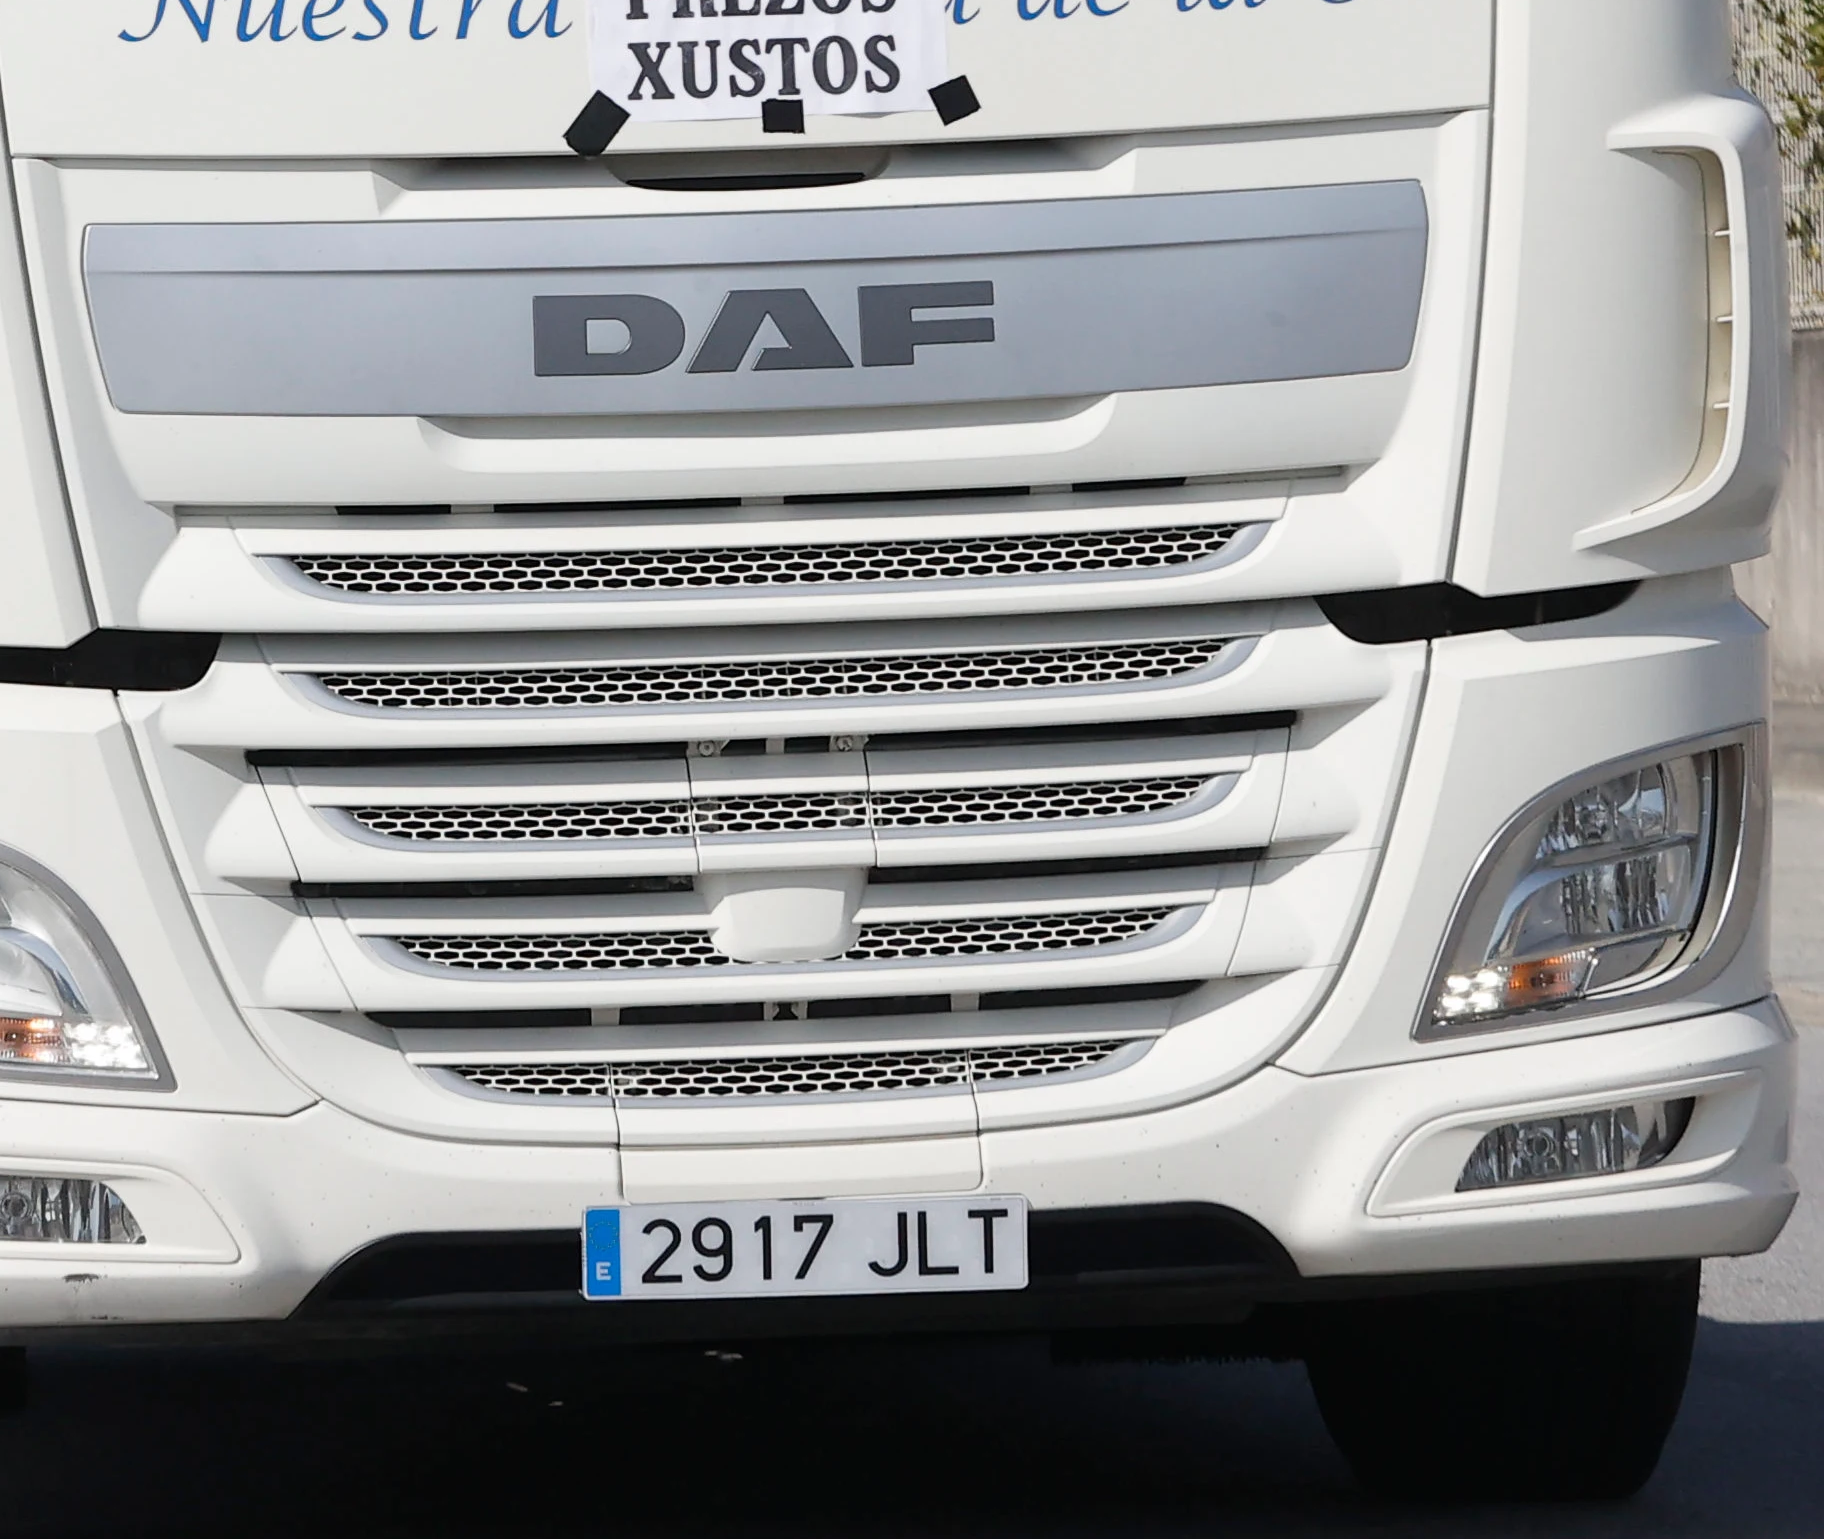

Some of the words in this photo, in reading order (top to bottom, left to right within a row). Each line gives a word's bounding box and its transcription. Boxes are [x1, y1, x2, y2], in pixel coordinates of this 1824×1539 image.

[627, 35, 900, 100] XUSTOS
[532, 280, 995, 377] DAF
[595, 1262, 612, 1281] E
[640, 1214, 834, 1284] 2917
[868, 1208, 1009, 1278] JLT
